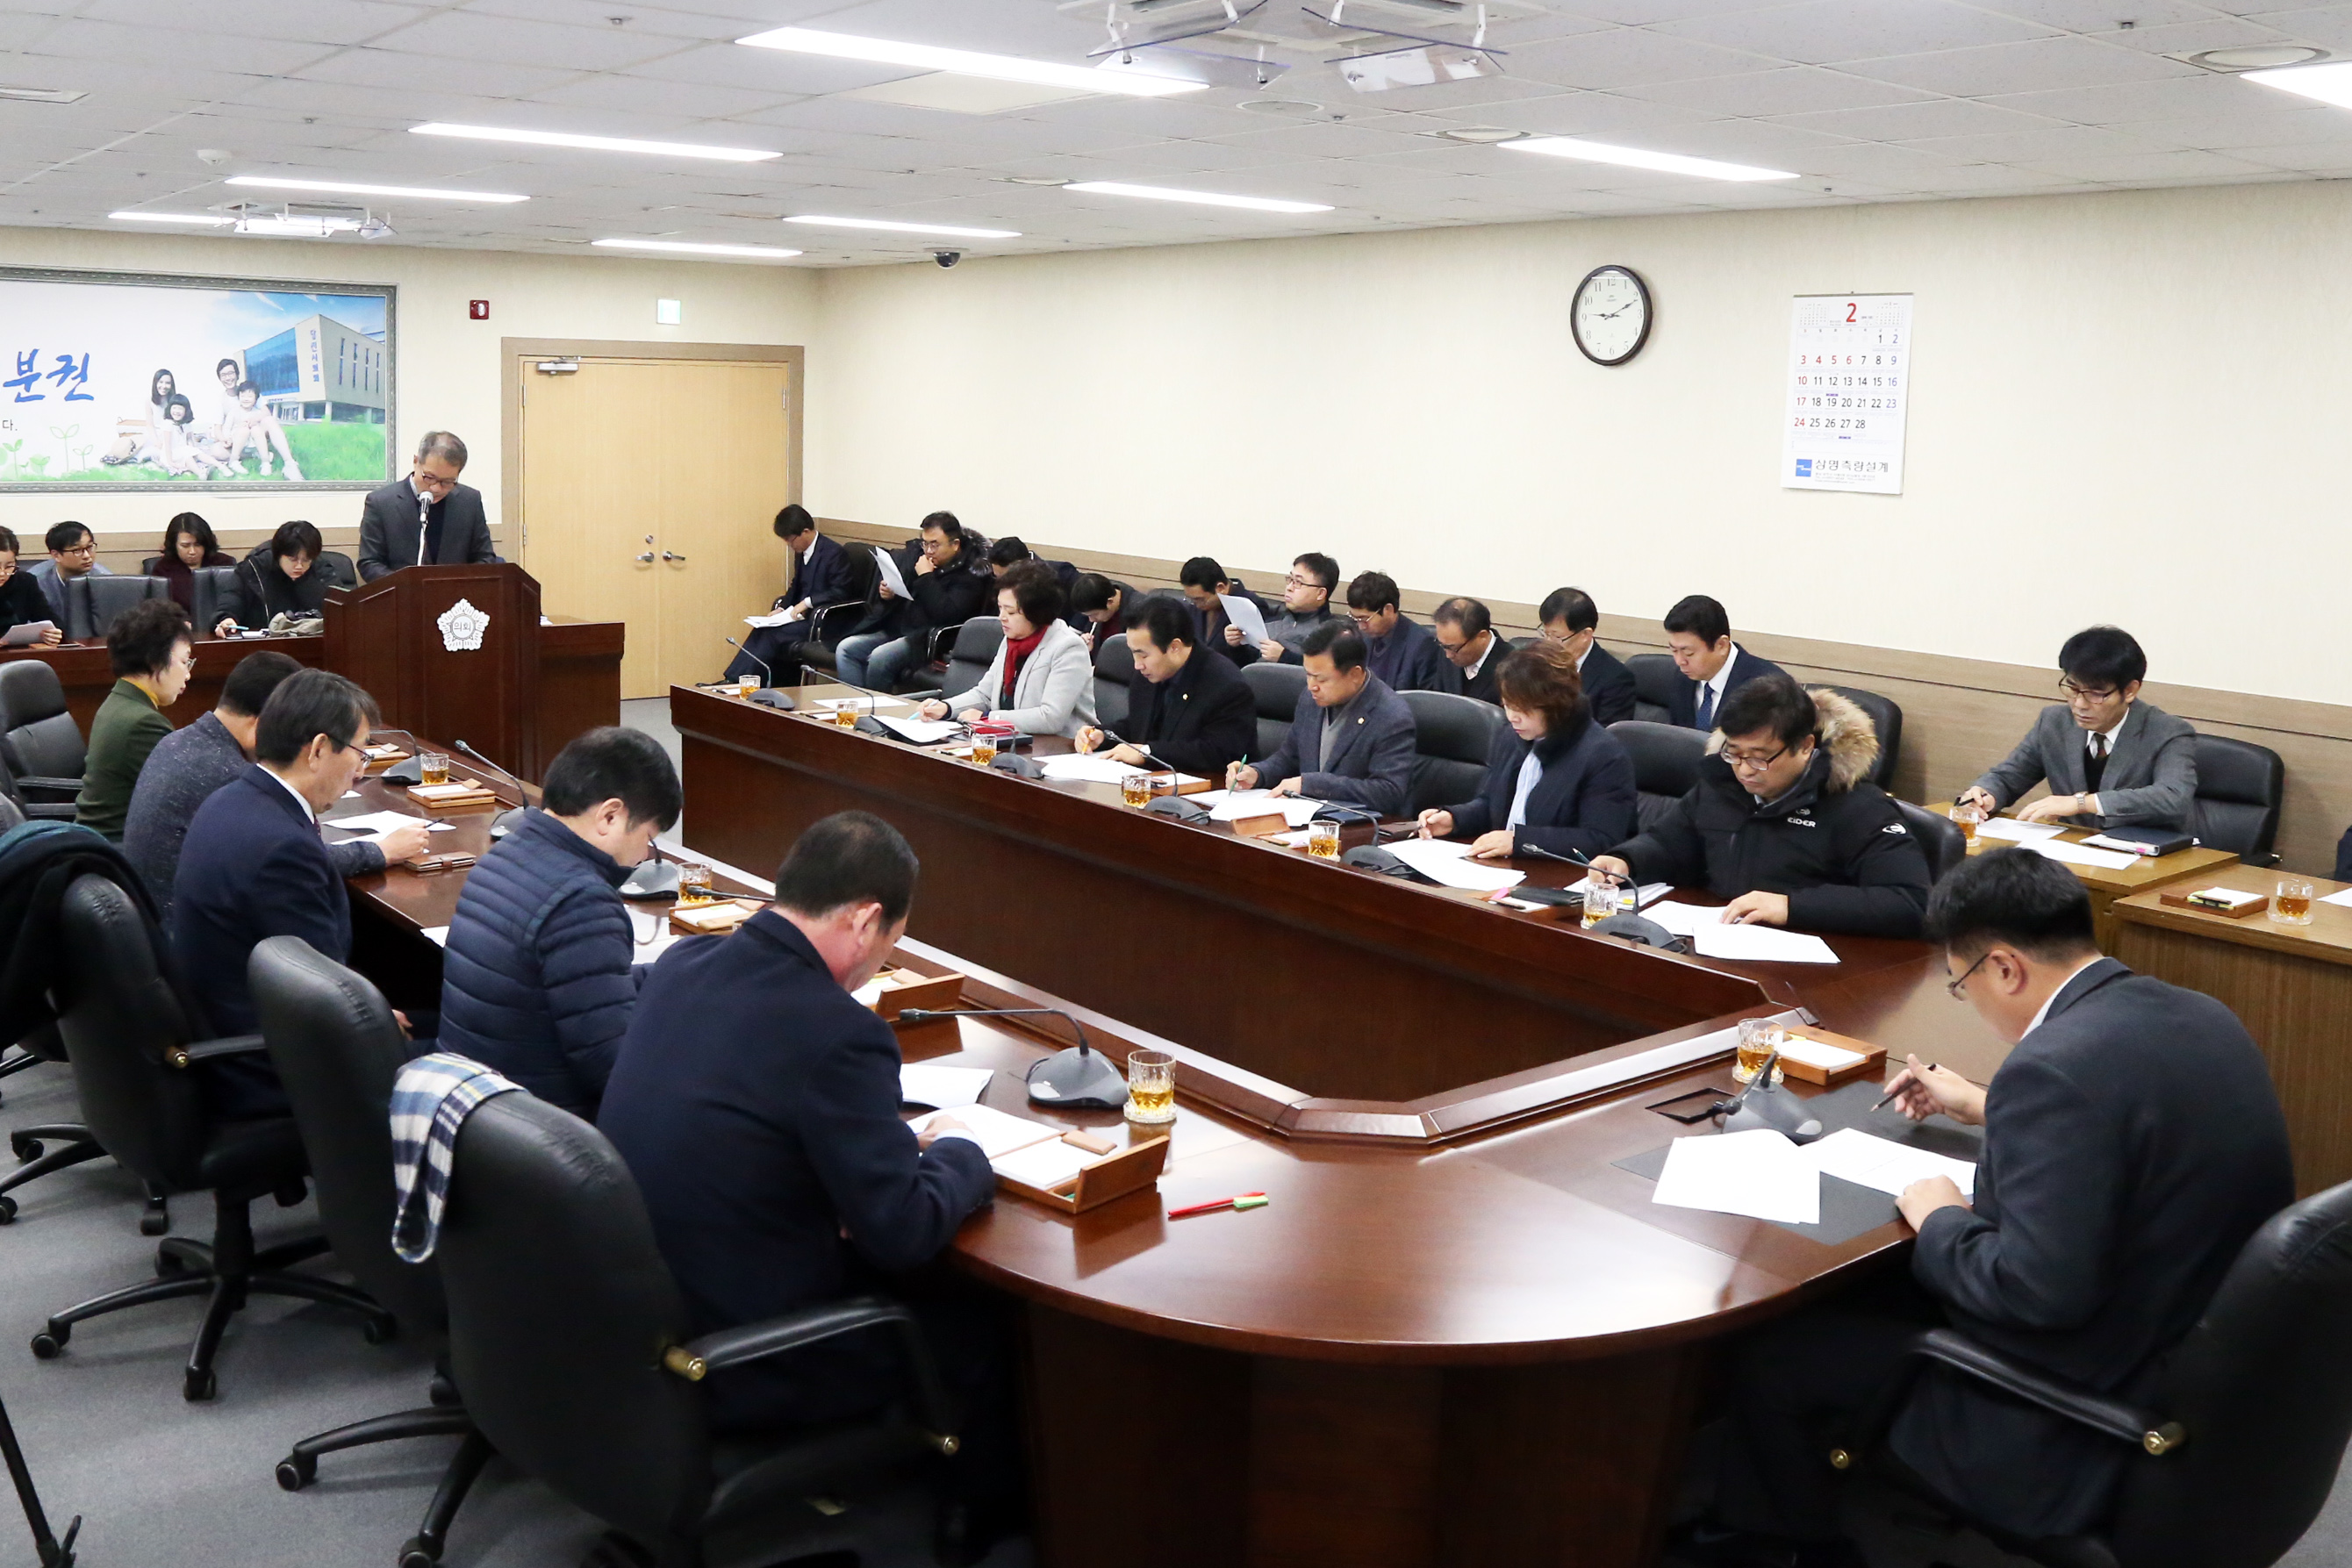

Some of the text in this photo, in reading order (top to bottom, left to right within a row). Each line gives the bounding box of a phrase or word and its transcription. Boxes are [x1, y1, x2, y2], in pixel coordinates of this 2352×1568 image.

[1595, 282, 1602, 292] 11
[1584, 296, 1593, 305] 10
[1846, 303, 1857, 323] 2
[1878, 334, 1898, 344] 1 2
[1801, 354, 1897, 365] 3 4 5 6 7 8 9
[3, 348, 94, 403] 분권
[1798, 376, 1897, 386] 10 11 12 13 14 15 16
[1797, 397, 1897, 408] 17 18 19 20 21 22 23
[1794, 418, 1866, 428] 24 25 26 27 28
[454, 622, 471, 632] 의회
